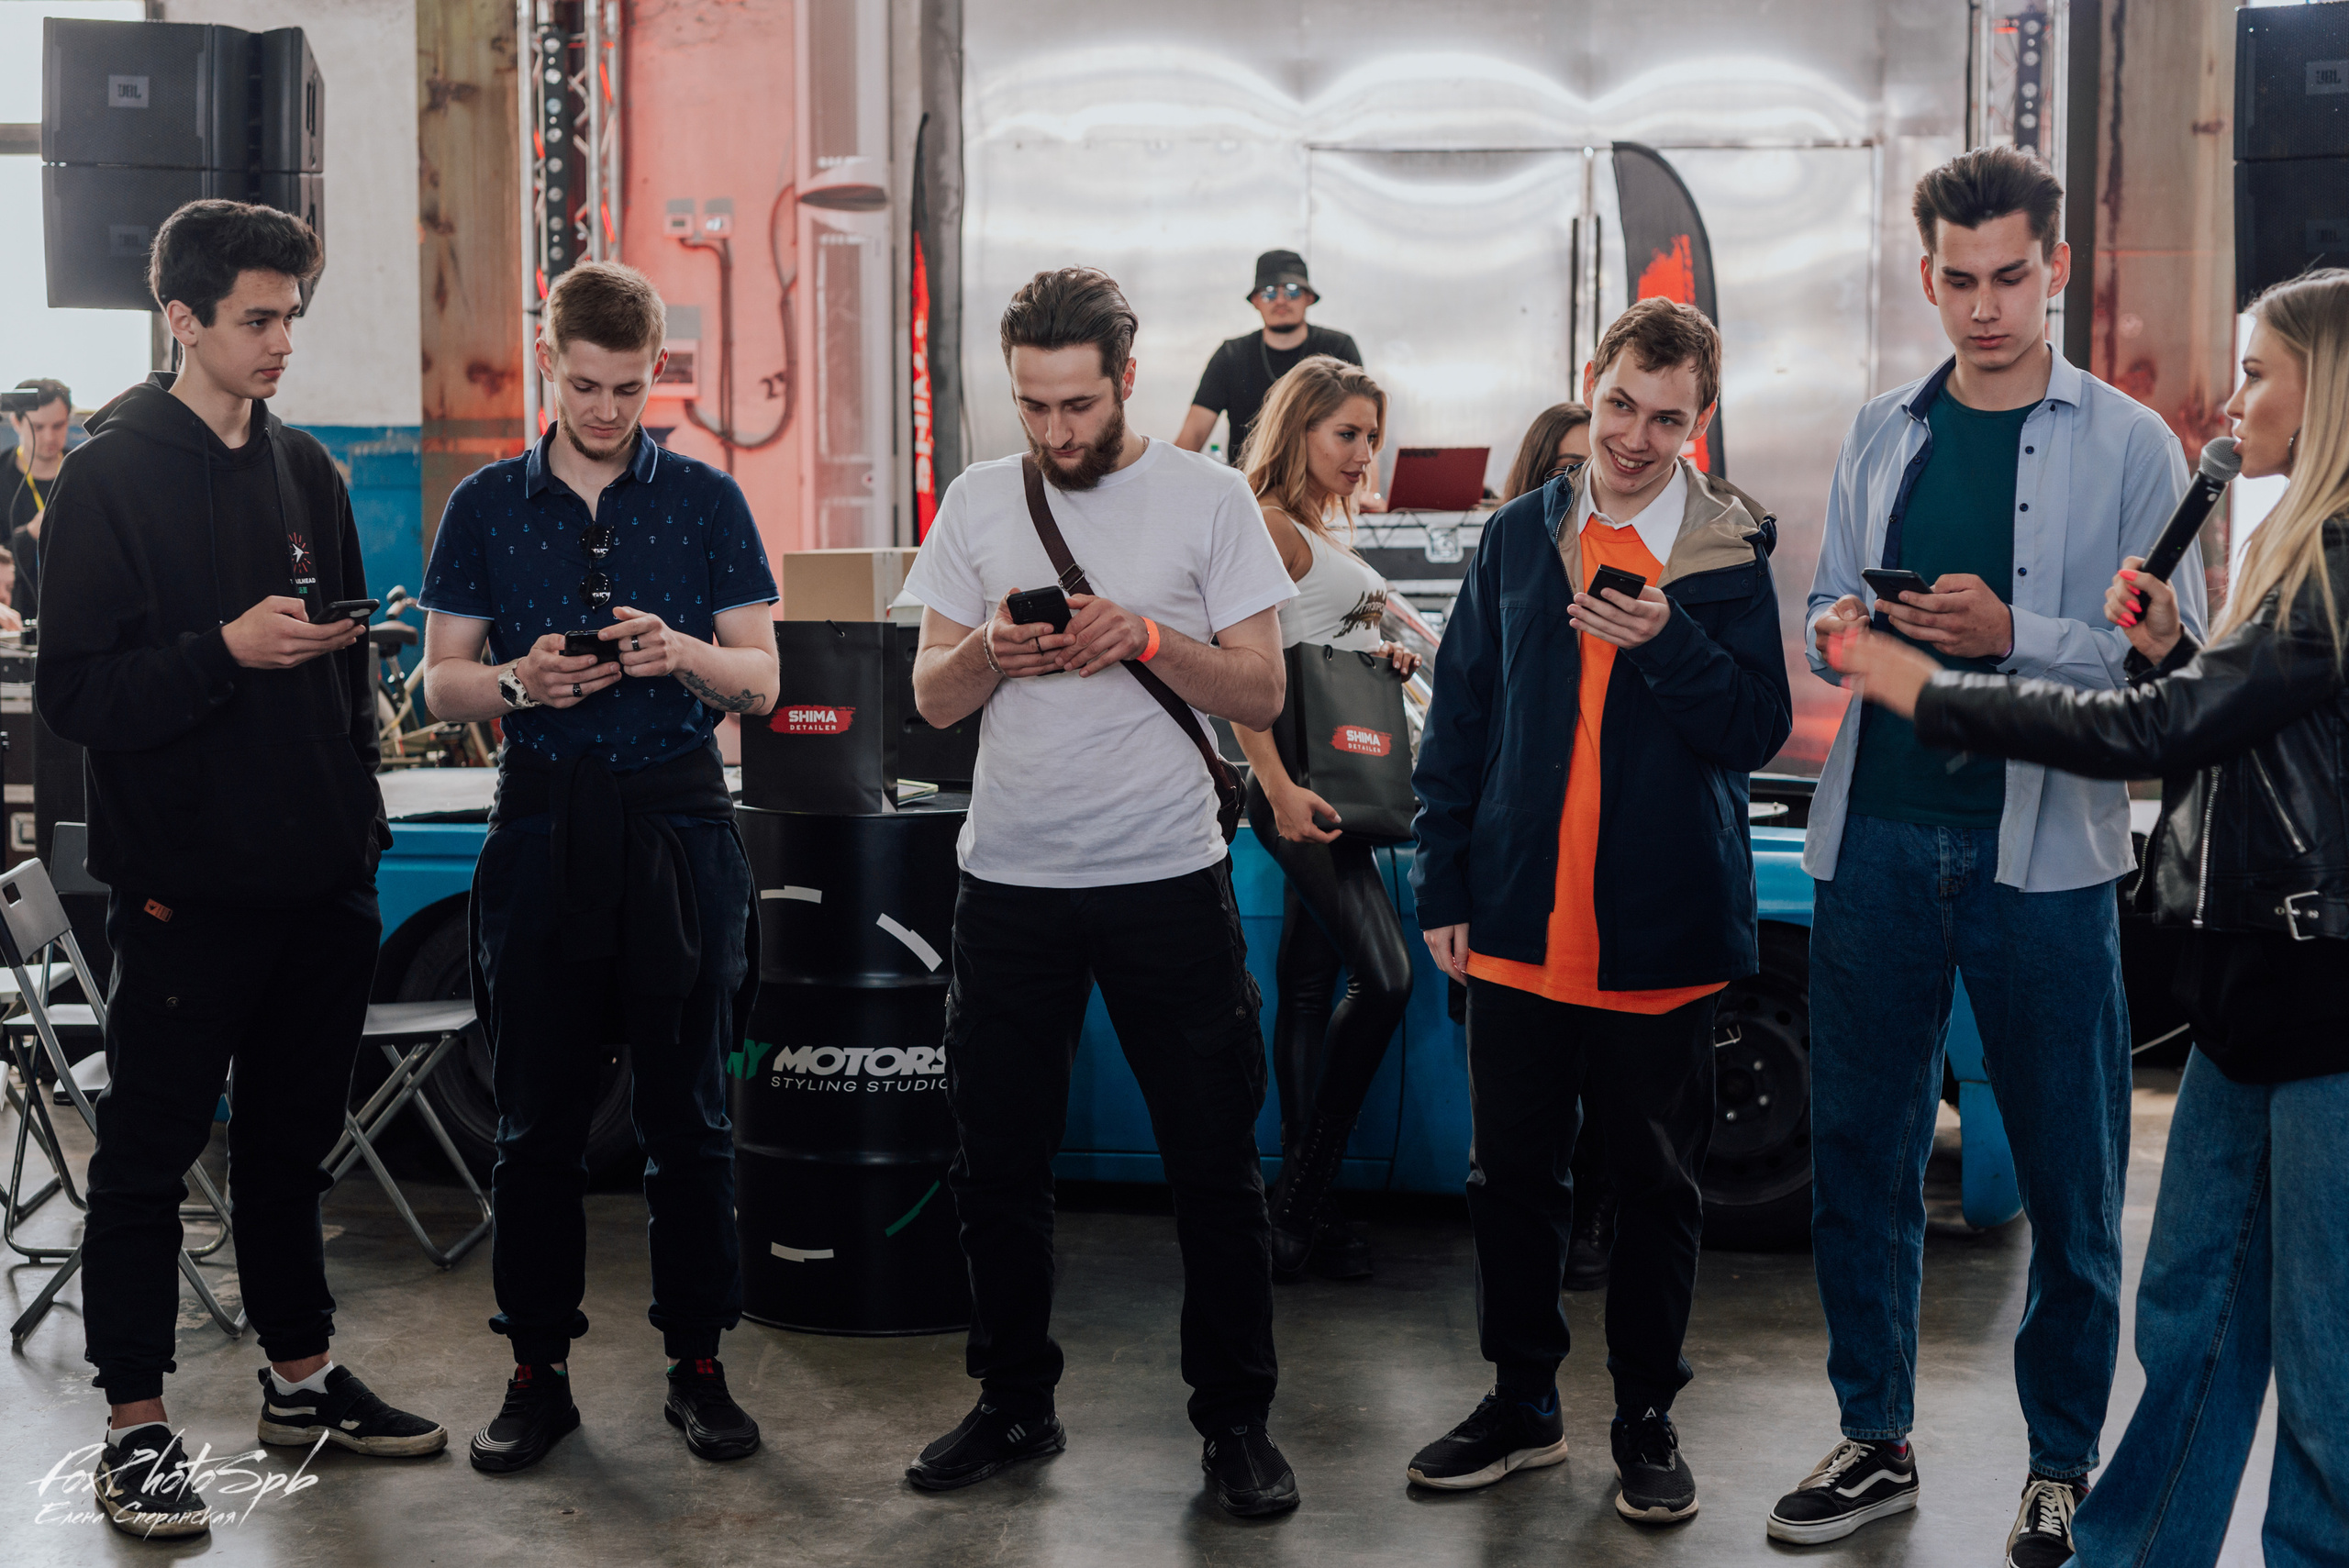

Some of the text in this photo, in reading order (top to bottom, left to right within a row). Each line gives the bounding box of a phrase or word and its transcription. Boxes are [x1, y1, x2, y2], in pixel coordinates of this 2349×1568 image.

[117, 83, 141, 99] JBL
[788, 710, 838, 723] SHIMA
[1346, 729, 1381, 746] SHIMA
[1348, 743, 1381, 753] DETAILER
[771, 1076, 857, 1092] STYLING
